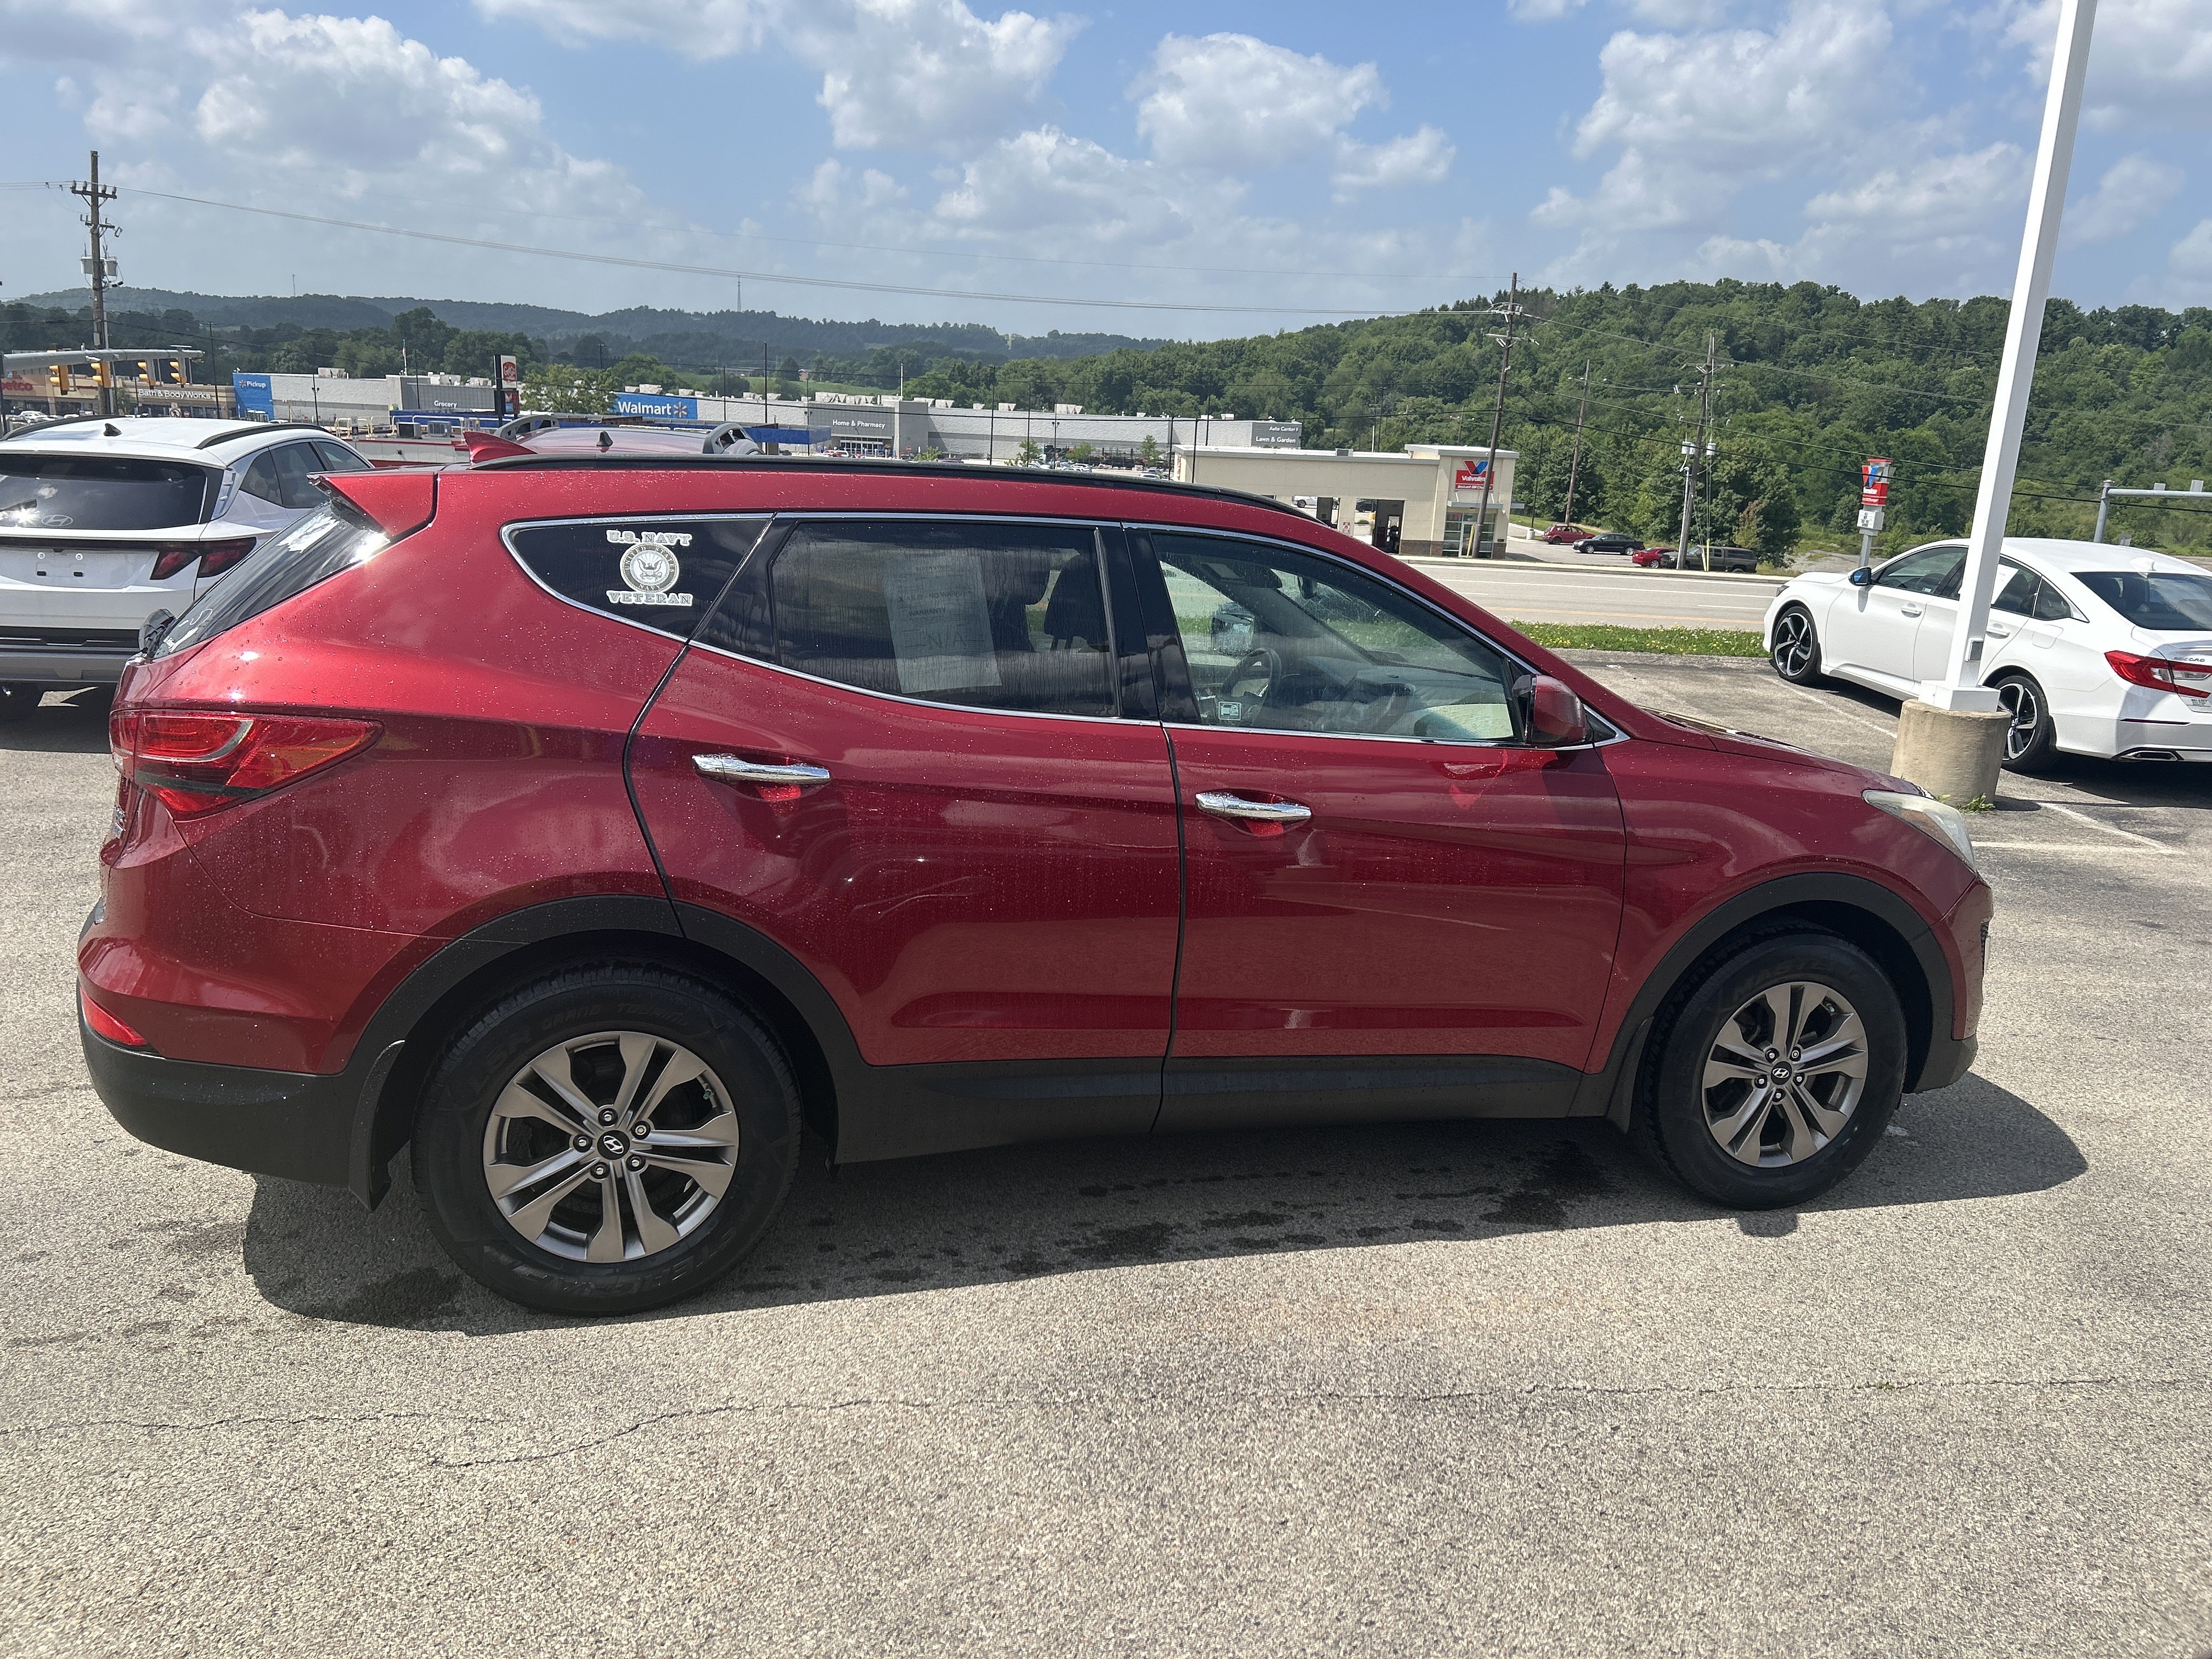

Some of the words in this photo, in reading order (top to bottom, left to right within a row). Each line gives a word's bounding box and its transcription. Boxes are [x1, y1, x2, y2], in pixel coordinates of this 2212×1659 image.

[246, 381, 267, 389] Pickup
[138, 388, 157, 397] Bath
[164, 391, 184, 400] Body
[184, 391, 211, 399] Works
[434, 400, 458, 409] Grocery
[617, 401, 672, 416] Walmart
[857, 420, 885, 430] Pharmacy
[608, 531, 639, 543] U.S.
[644, 533, 691, 545] NAVY
[624, 546, 646, 570] UNITED
[654, 546, 675, 573] STATES
[638, 583, 661, 591] NAVY
[608, 591, 691, 605] VETERAN
[909, 607, 946, 616] WARRANTY
